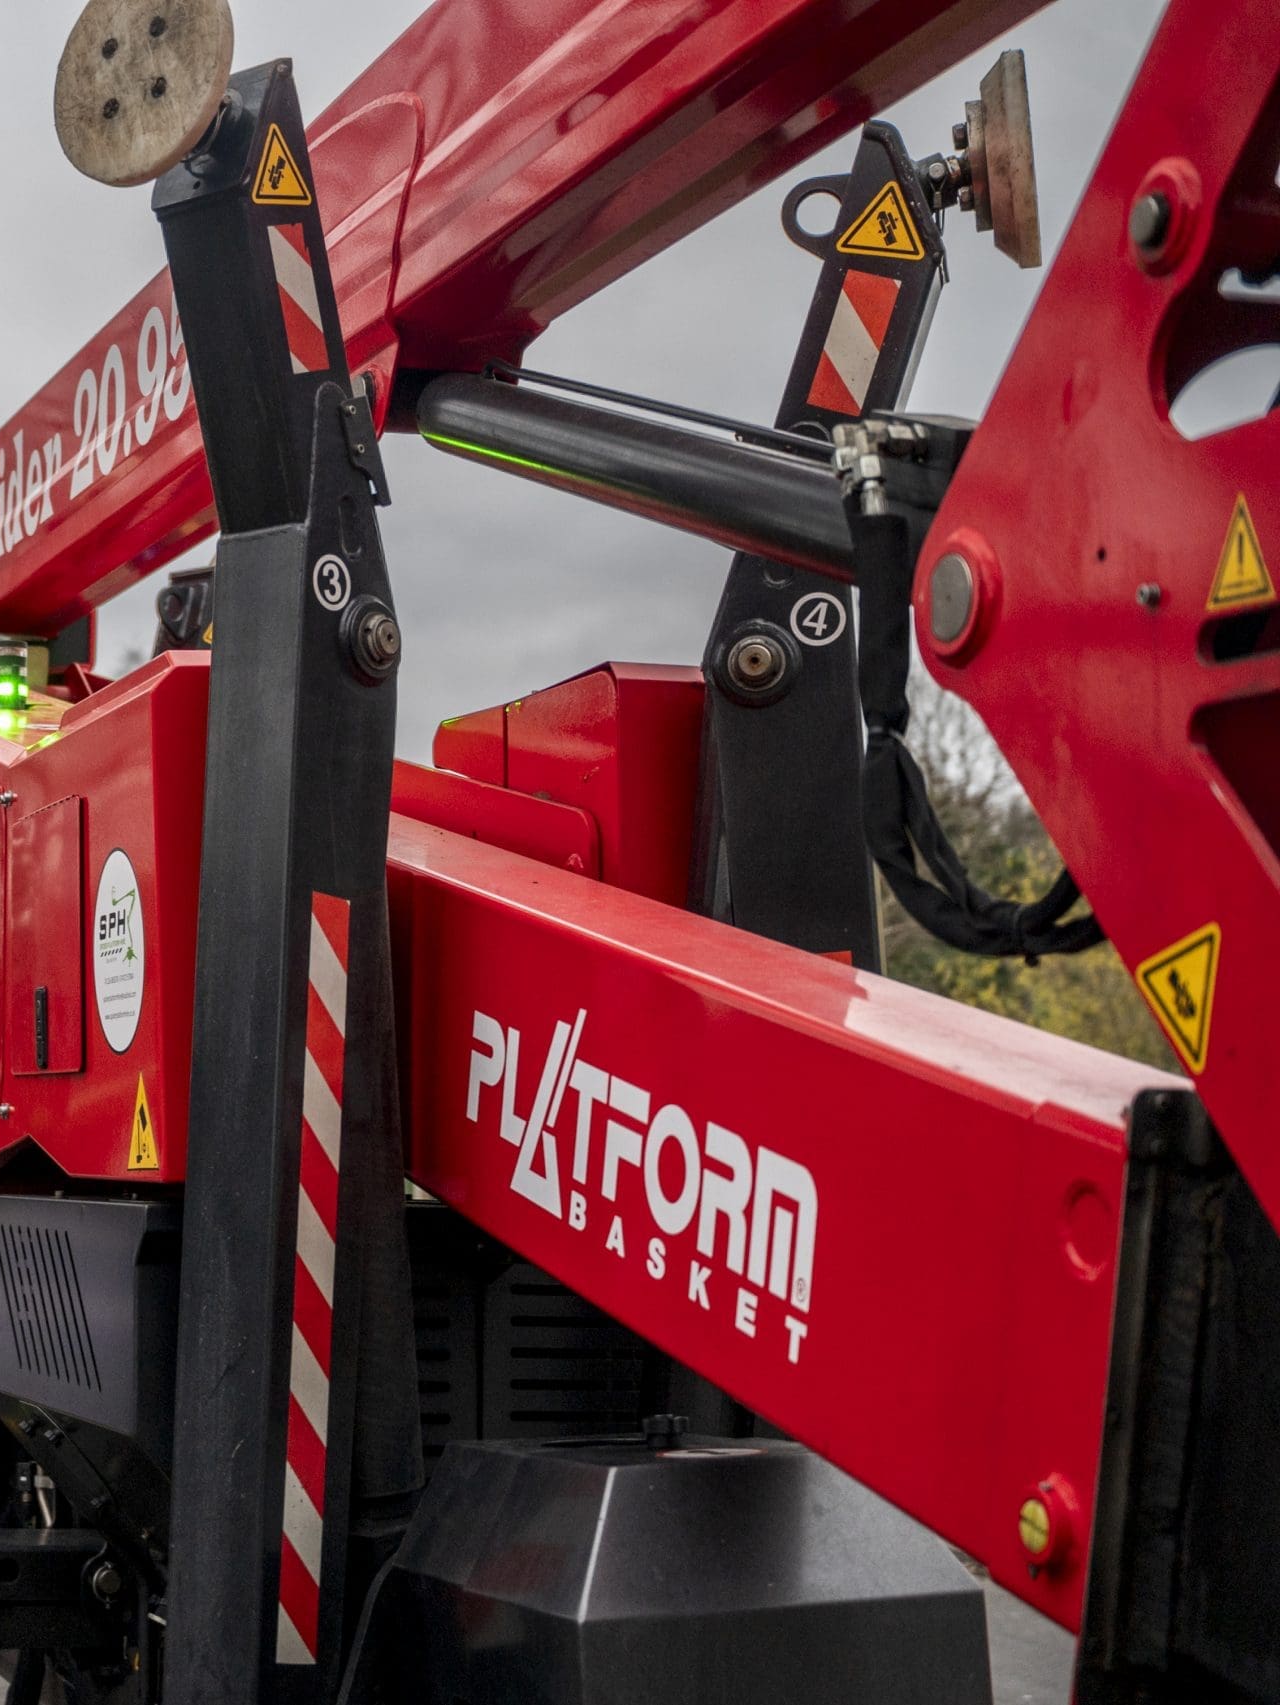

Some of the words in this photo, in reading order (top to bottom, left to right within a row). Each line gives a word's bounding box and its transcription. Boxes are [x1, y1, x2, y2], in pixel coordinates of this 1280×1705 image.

[323, 563, 342, 602] 3
[802, 601, 828, 636] 4
[100, 908, 126, 940] SPH
[465, 1007, 819, 1314] PLATFORM
[567, 1189, 809, 1365] BASKET
